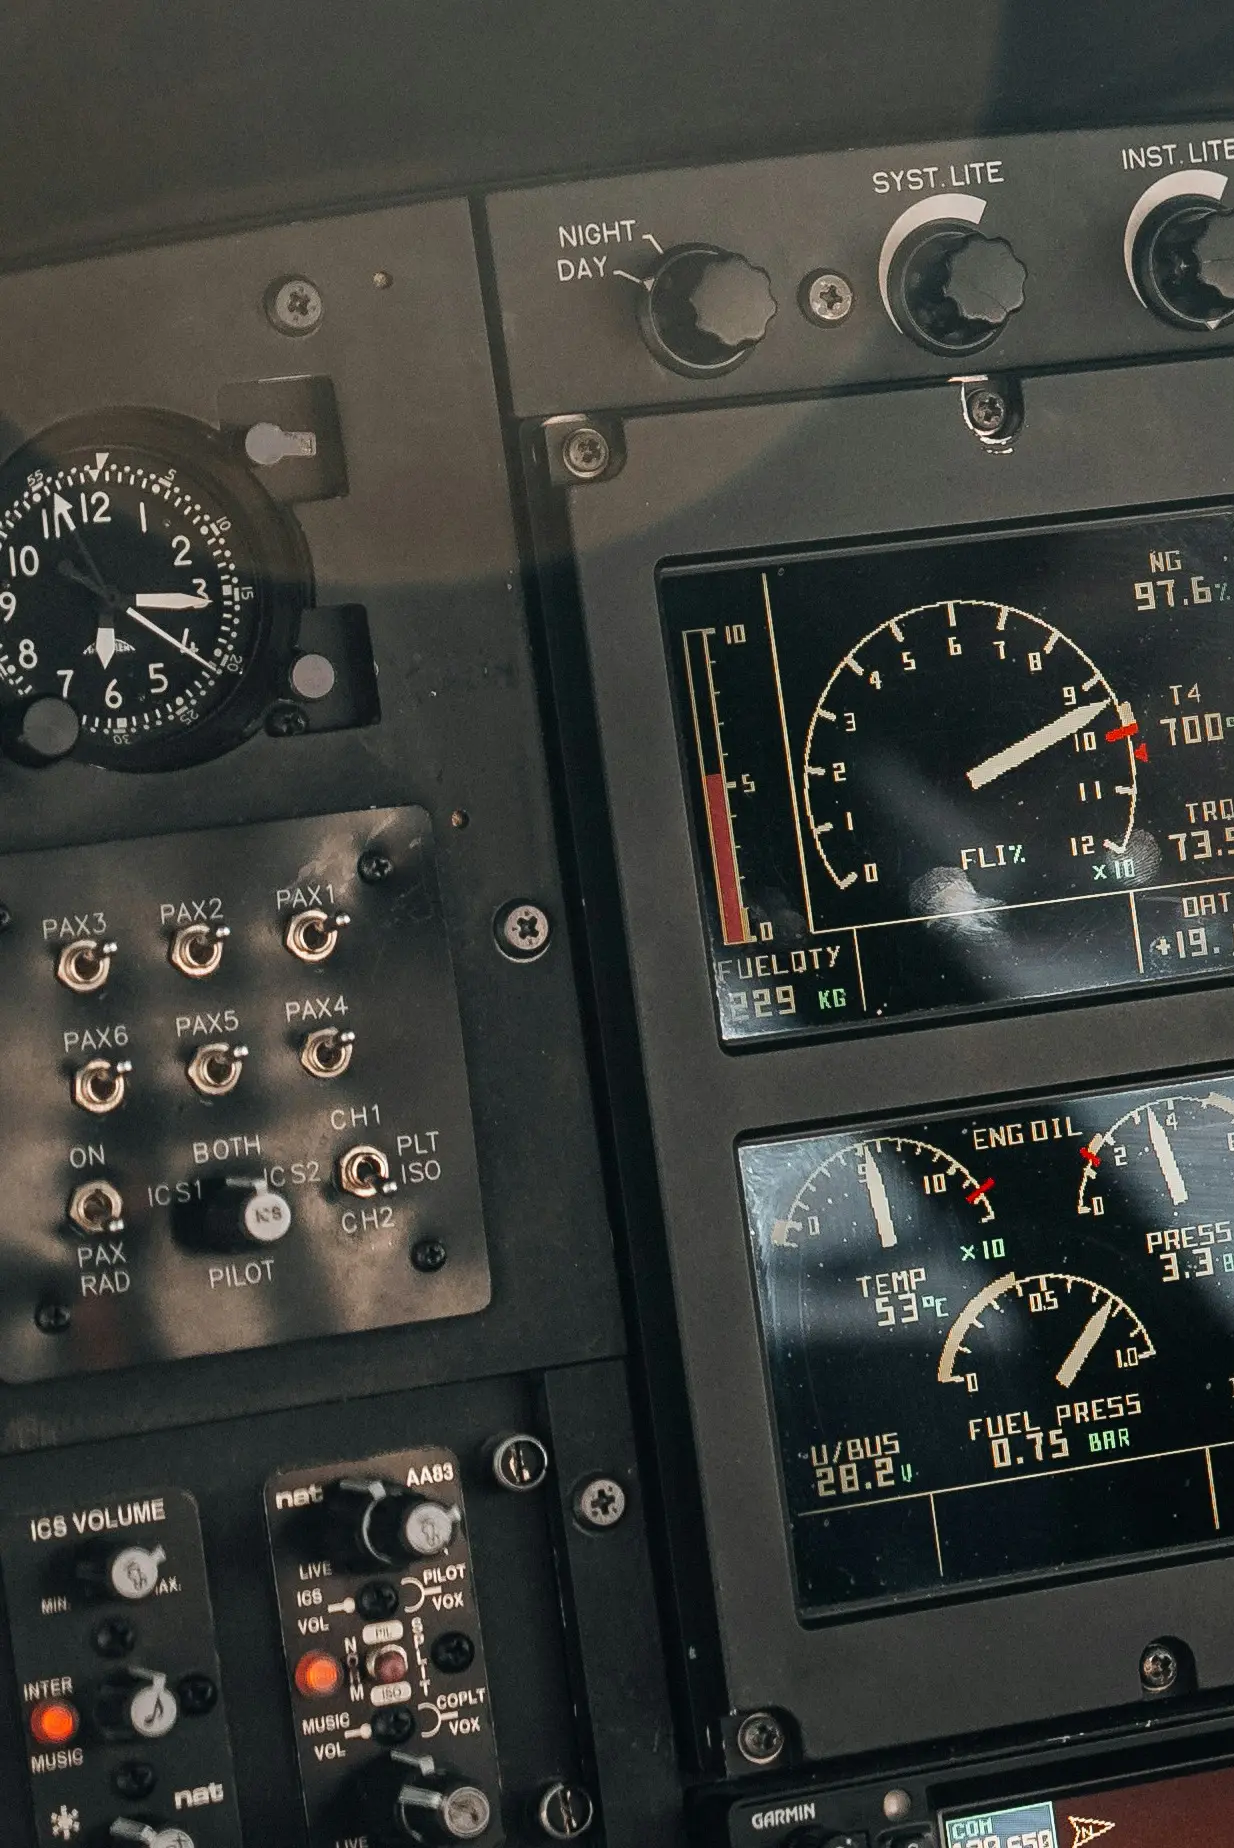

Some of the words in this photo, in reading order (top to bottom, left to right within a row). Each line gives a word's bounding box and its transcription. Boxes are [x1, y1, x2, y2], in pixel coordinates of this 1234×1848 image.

[1122, 144, 1183, 170] INST.
[872, 167, 948, 195] SYST.
[951, 161, 1004, 187] LITE
[559, 220, 636, 248] NIGHT
[557, 256, 607, 283] DAY
[80, 491, 112, 523] 12
[139, 501, 148, 534] 1
[8, 544, 40, 578] 10
[171, 535, 193, 566] 2
[1148, 549, 1183, 574] NG
[725, 624, 747, 646] 10
[947, 636, 963, 657] 6
[18, 638, 39, 669] 8
[902, 651, 917, 671] 5
[993, 640, 1007, 661] 7
[1028, 653, 1043, 672] 8
[57, 669, 74, 699] 7
[148, 662, 169, 693] 5
[869, 670, 883, 690] 4
[104, 678, 124, 709] 6
[1062, 686, 1077, 706] 9
[844, 712, 857, 732] 3
[1074, 731, 1097, 752] 10
[741, 773, 756, 793] 5
[832, 762, 848, 782] 2
[1078, 781, 1103, 801] 11
[845, 812, 855, 832] 1
[1070, 836, 1095, 857] 12
[863, 863, 878, 883] 0
[276, 883, 336, 909] PAX1
[1181, 891, 1233, 918] OAT
[159, 897, 224, 923] PAX2
[42, 913, 108, 941] PAX3
[285, 996, 349, 1024] PAX4
[818, 988, 847, 1011] KG
[175, 1010, 240, 1038] PAX5
[63, 1025, 130, 1053] PAX6
[330, 1104, 383, 1131] CH1
[1165, 1111, 1180, 1132] 4
[396, 1131, 440, 1156] PLT
[973, 1121, 1026, 1152] ENG
[1031, 1116, 1084, 1143] OIL
[69, 1145, 106, 1168] ON
[192, 1134, 262, 1164] BOTH
[1113, 1146, 1128, 1168] 2
[401, 1160, 442, 1185] ISO
[923, 1173, 947, 1195] 10
[1090, 1196, 1105, 1217] 0
[341, 1206, 396, 1234] CH2
[1145, 1222, 1234, 1254] PRESS
[77, 1243, 127, 1269] PAX
[80, 1270, 132, 1297] RAD
[208, 1259, 275, 1289] PILOT
[856, 1268, 928, 1299] TEMP
[965, 1372, 981, 1394] 0
[968, 1411, 1041, 1441] FUEL
[1056, 1393, 1143, 1425] PRESS
[810, 1433, 901, 1467] U/BUS
[991, 1429, 1070, 1469] 0.75
[1088, 1428, 1131, 1454] BAR
[405, 1463, 455, 1488] AA83
[275, 1484, 324, 1510] nat
[30, 1514, 67, 1542] ICS
[72, 1498, 166, 1534] VOLUME
[299, 1561, 332, 1581] LIVE
[423, 1562, 466, 1585] PILOT
[296, 1587, 323, 1607] ICS
[431, 1591, 464, 1612] VOX
[298, 1615, 330, 1636] VOL
[23, 1676, 73, 1702] INTER
[436, 1687, 486, 1711] COPLT
[301, 1712, 350, 1736] MUSIC
[448, 1716, 481, 1737] VOX
[30, 1747, 84, 1774] MUSIC
[314, 1742, 347, 1762] VOL
[174, 1781, 225, 1811] nat
[751, 1802, 816, 1830] GARMIN
